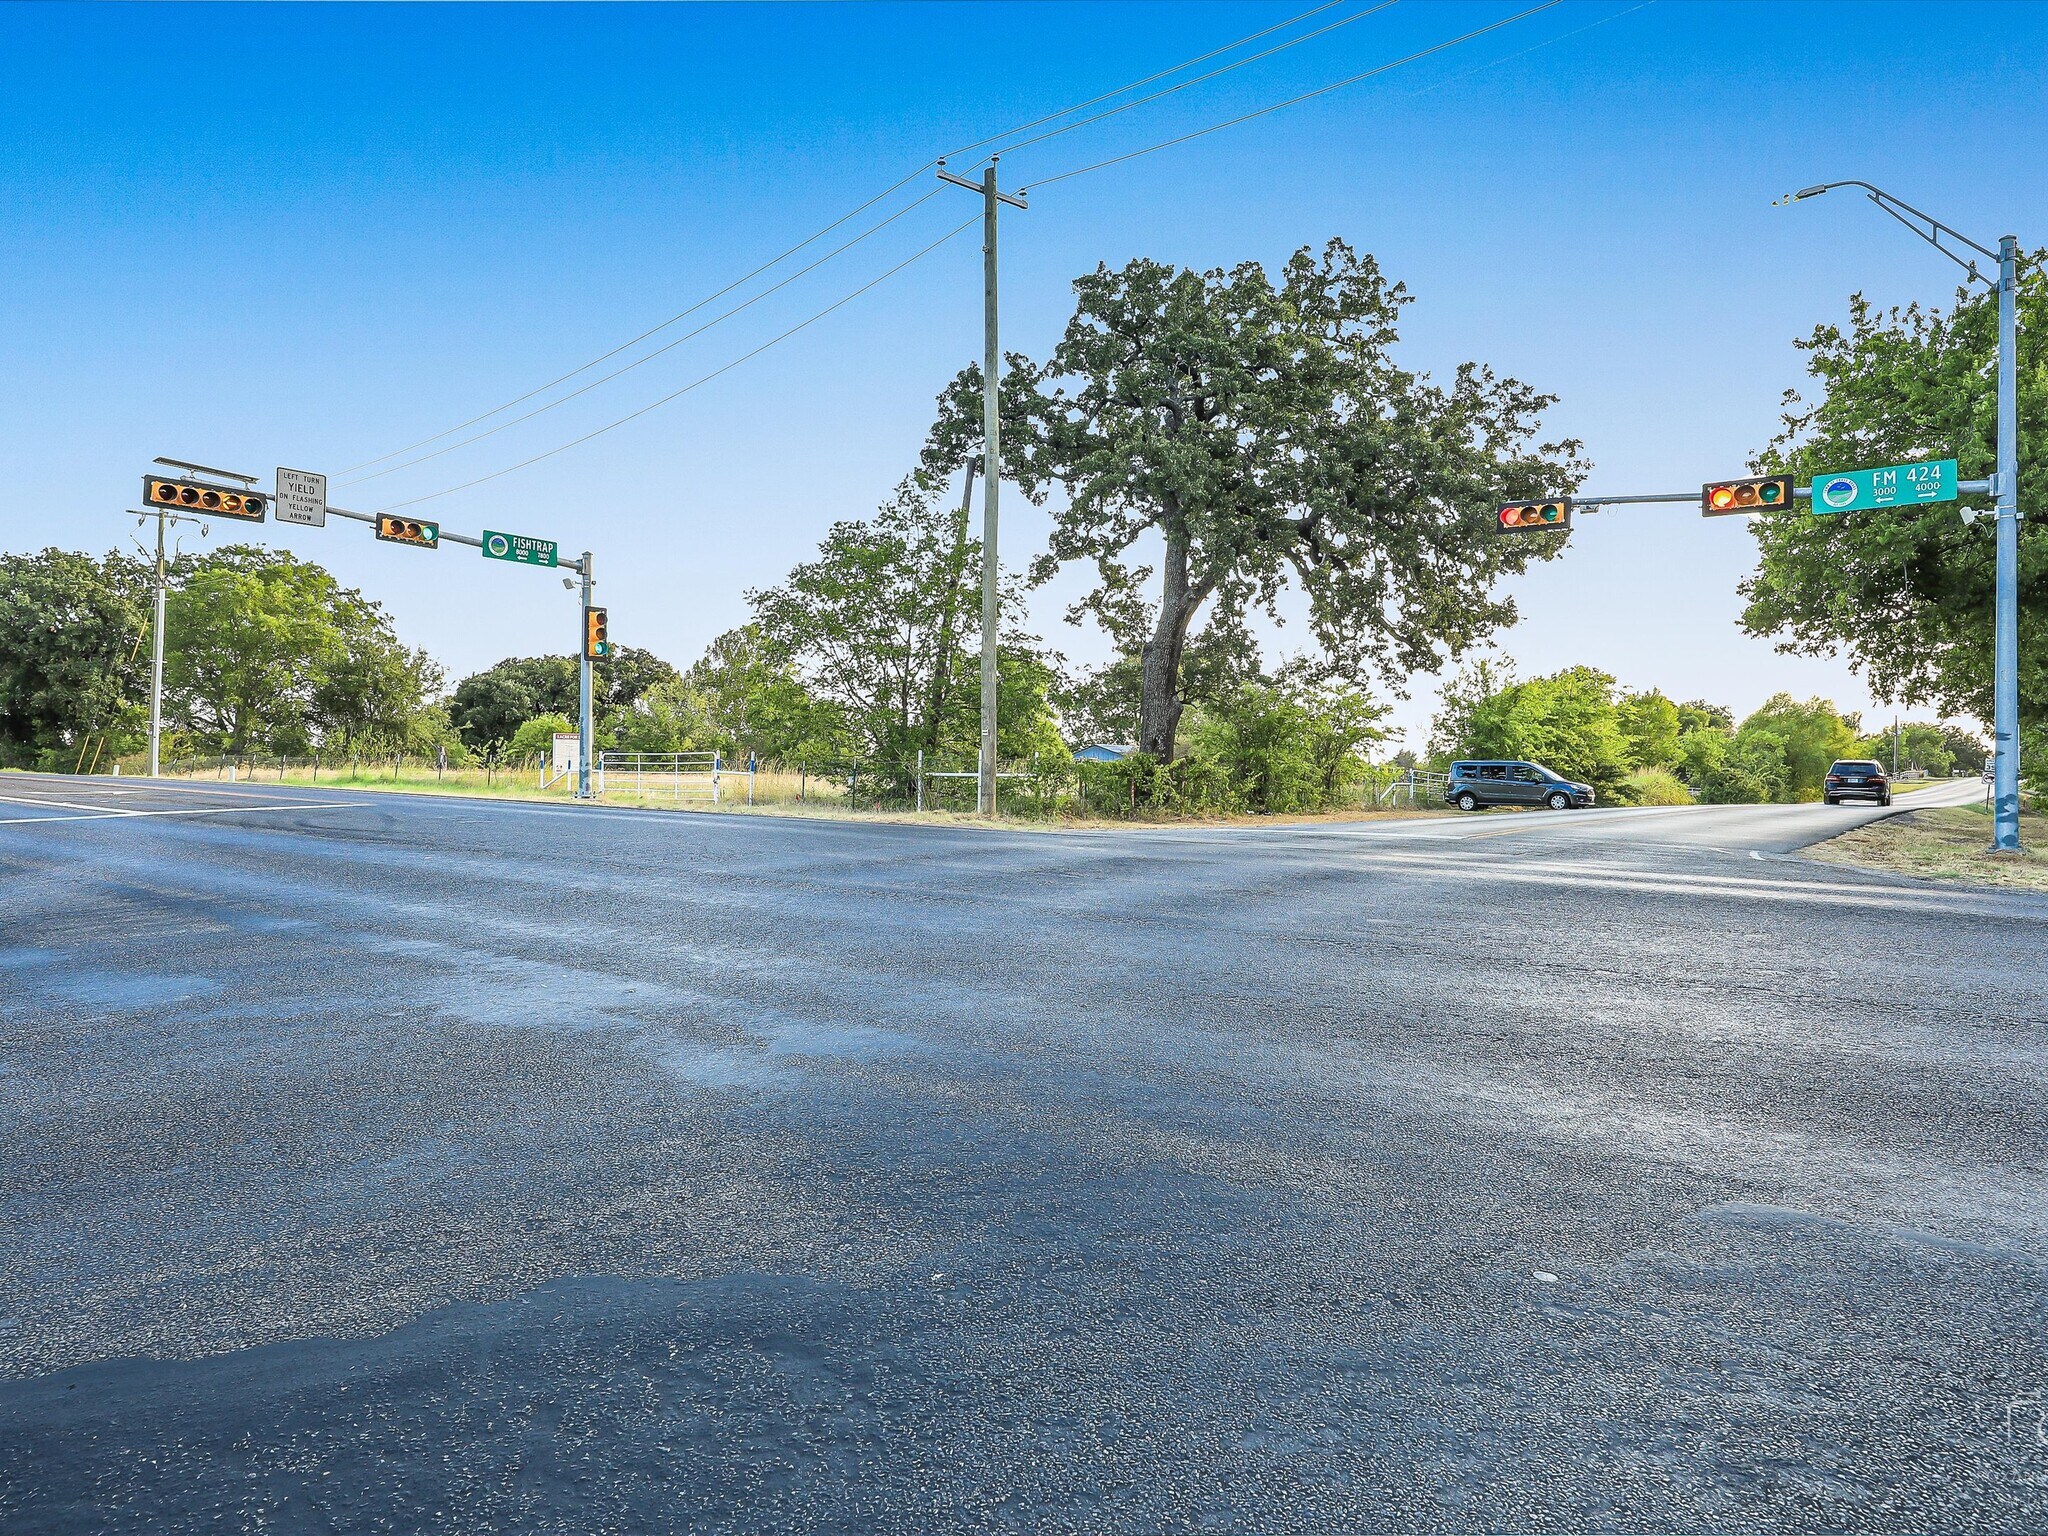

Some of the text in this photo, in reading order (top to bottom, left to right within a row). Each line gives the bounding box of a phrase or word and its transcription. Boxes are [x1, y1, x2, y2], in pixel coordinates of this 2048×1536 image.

[304, 476, 320, 484] TURN
[1873, 470, 1897, 487] FM
[1906, 465, 1942, 483] 424
[288, 482, 315, 495] YIELD
[1873, 481, 1940, 497] 3000 4000
[292, 494, 323, 505] FLASHING
[288, 503, 314, 512] YELLOW
[289, 512, 312, 521] ARROW
[512, 537, 553, 553] FISHTRAP
